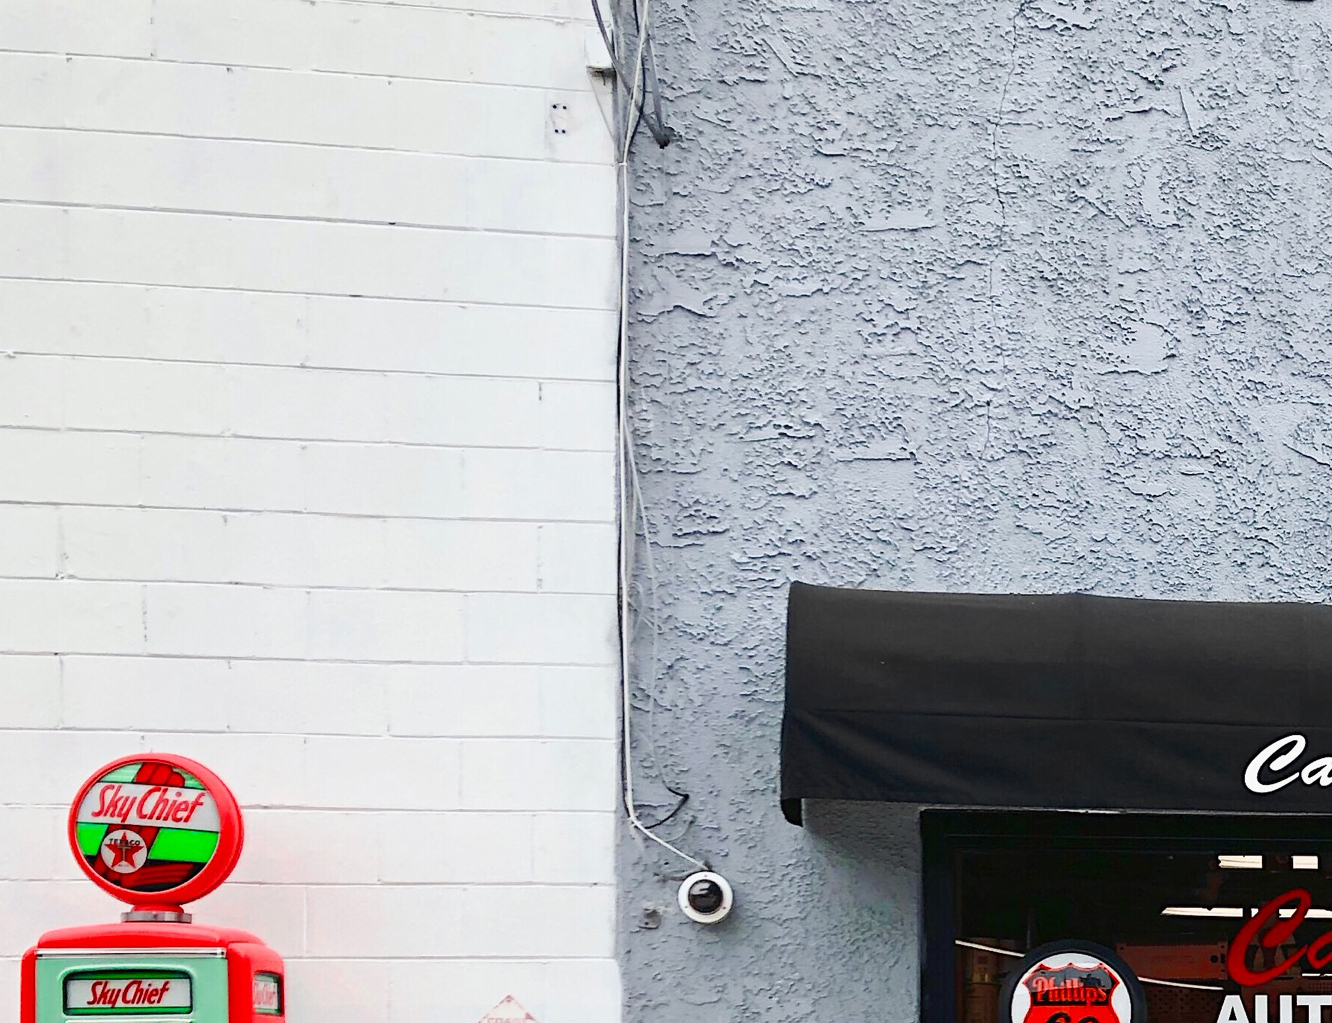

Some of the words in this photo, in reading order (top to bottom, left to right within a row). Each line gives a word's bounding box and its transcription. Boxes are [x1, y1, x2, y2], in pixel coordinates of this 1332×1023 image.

[91, 784, 137, 824] Sky
[137, 787, 204, 824] Chief
[87, 980, 120, 1008] Sky
[120, 980, 170, 1004] Chief
